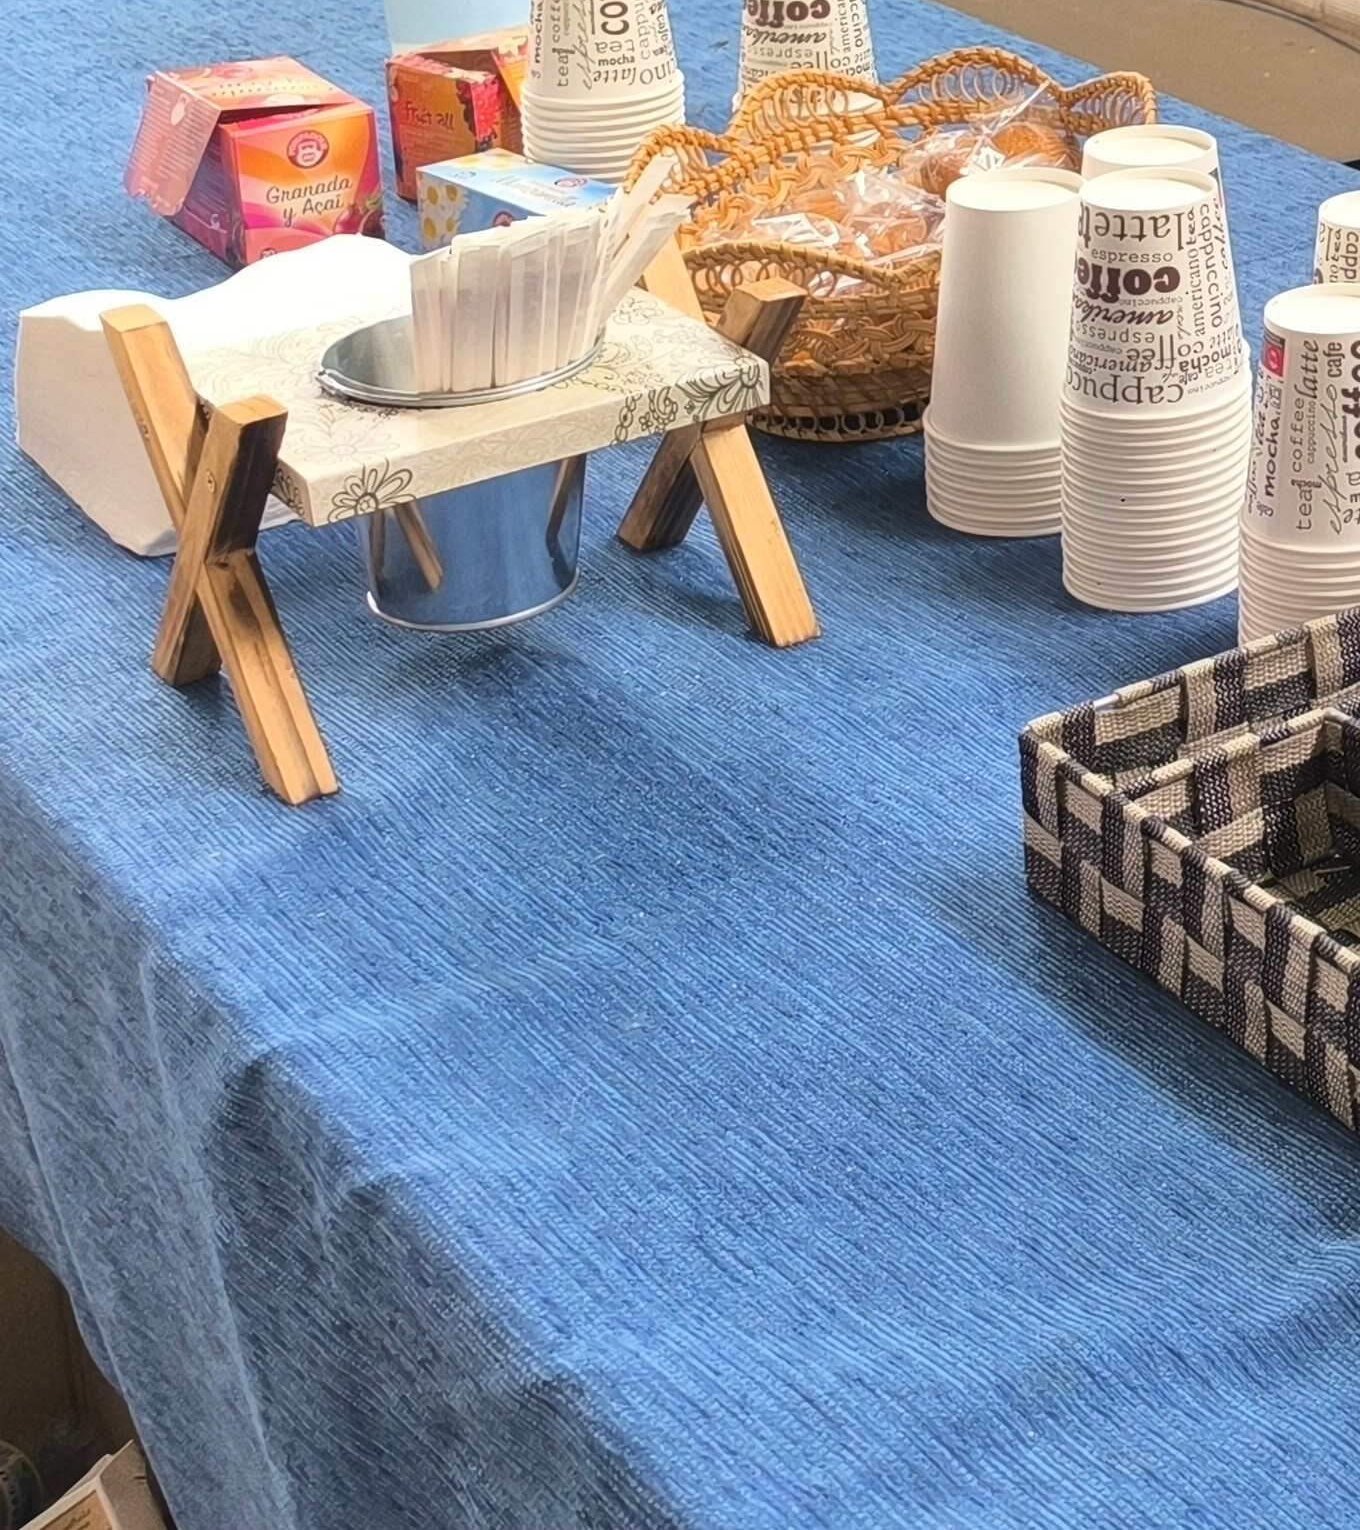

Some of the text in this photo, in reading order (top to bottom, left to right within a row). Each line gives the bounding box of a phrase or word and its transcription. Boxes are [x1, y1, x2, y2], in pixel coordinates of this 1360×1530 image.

[534, 0, 545, 64] mocha
[595, 38, 636, 54] tea
[556, 51, 570, 87] tea
[593, 67, 637, 86] latte
[598, 54, 636, 67] mocha
[266, 174, 354, 205] Granada
[283, 207, 297, 228] y
[1094, 210, 1185, 252] latte
[1186, 205, 1197, 246] tea
[1091, 249, 1174, 264] espresso
[1198, 202, 1224, 329] cappuccino
[1118, 296, 1184, 307] cappuccino
[1186, 249, 1206, 338] americano
[1075, 319, 1156, 344] espresso
[1178, 348, 1233, 373] mocha
[1294, 339, 1319, 400] latte
[1323, 341, 1346, 378] cafe
[1291, 397, 1304, 473] coffee
[1307, 400, 1317, 464] cappuccino
[1265, 419, 1281, 497] mocha
[1318, 383, 1348, 535] espresso
[1296, 487, 1313, 531] tea
